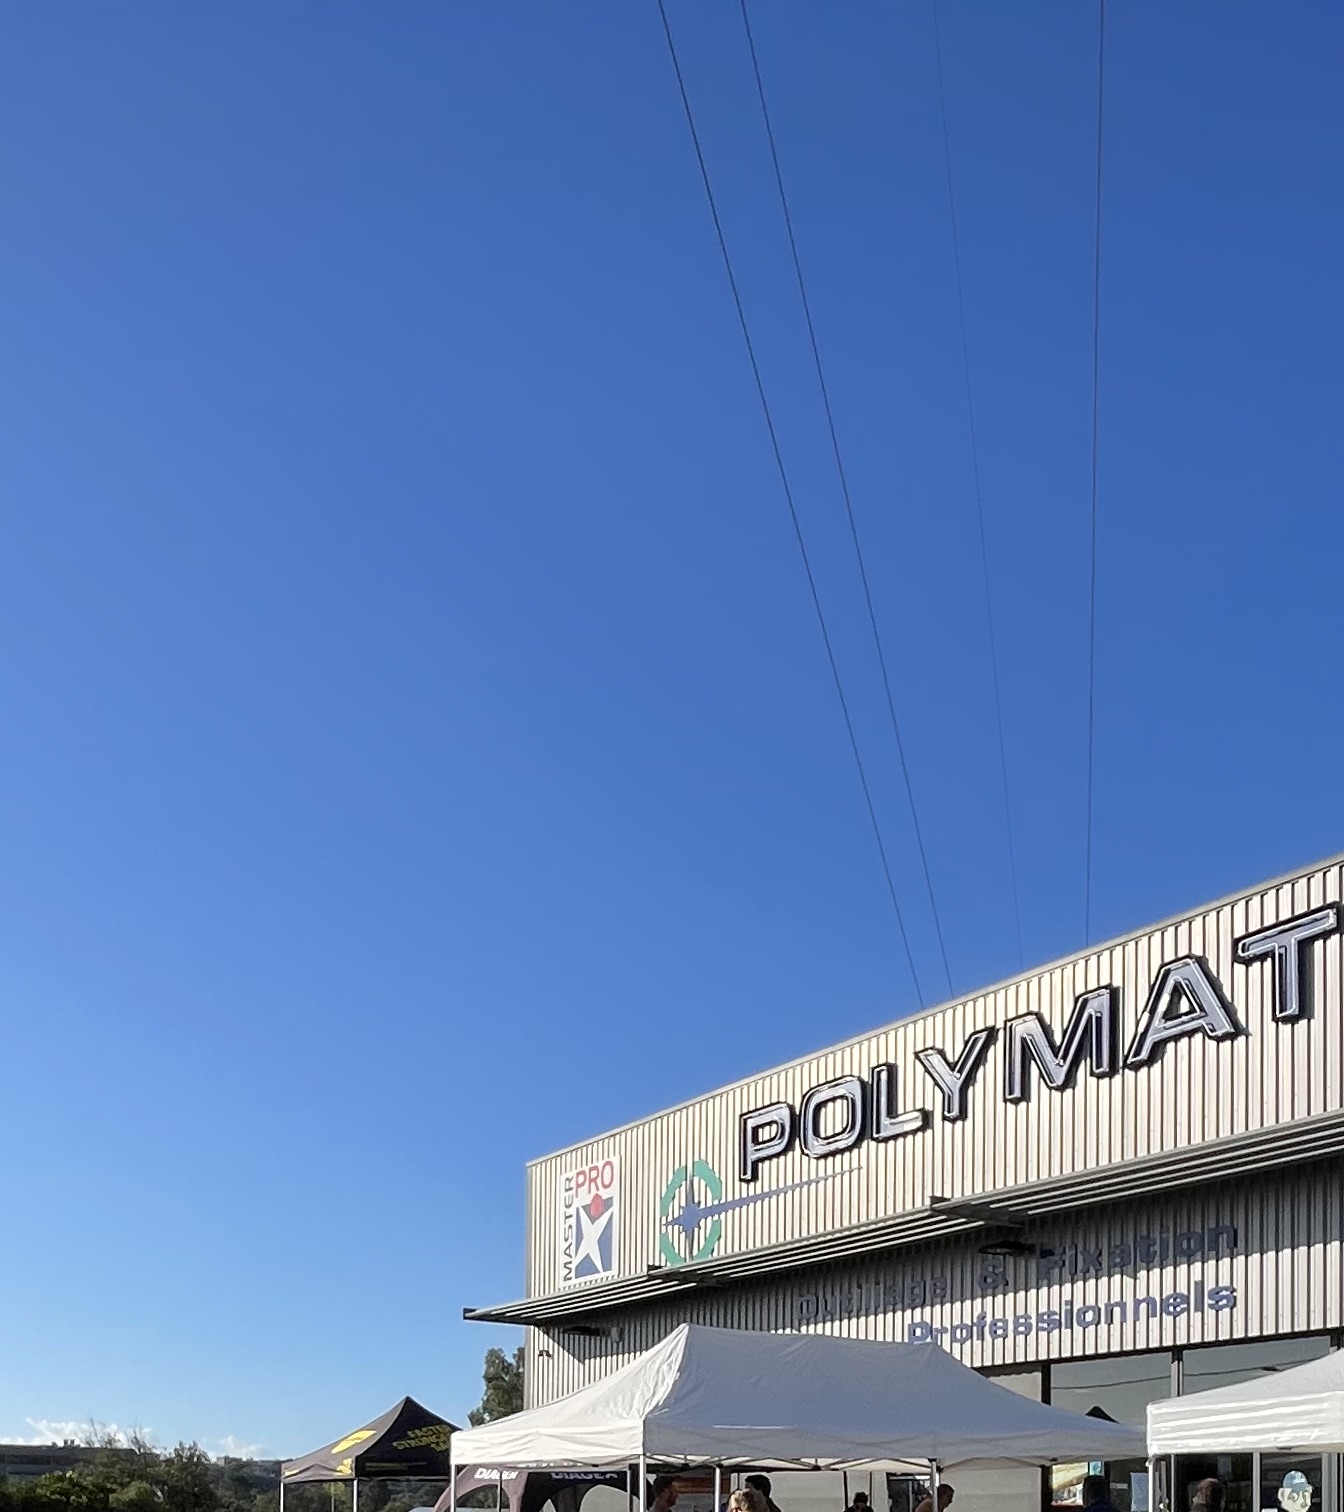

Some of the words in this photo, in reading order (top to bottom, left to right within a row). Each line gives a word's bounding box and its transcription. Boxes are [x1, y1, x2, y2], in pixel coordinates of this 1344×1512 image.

[575, 1160, 615, 1199] PRO
[563, 1175, 574, 1282] MASTER
[978, 1256, 1009, 1291] &
[1038, 1225, 1238, 1282] Fixation
[907, 1279, 1238, 1345] Professionnels
